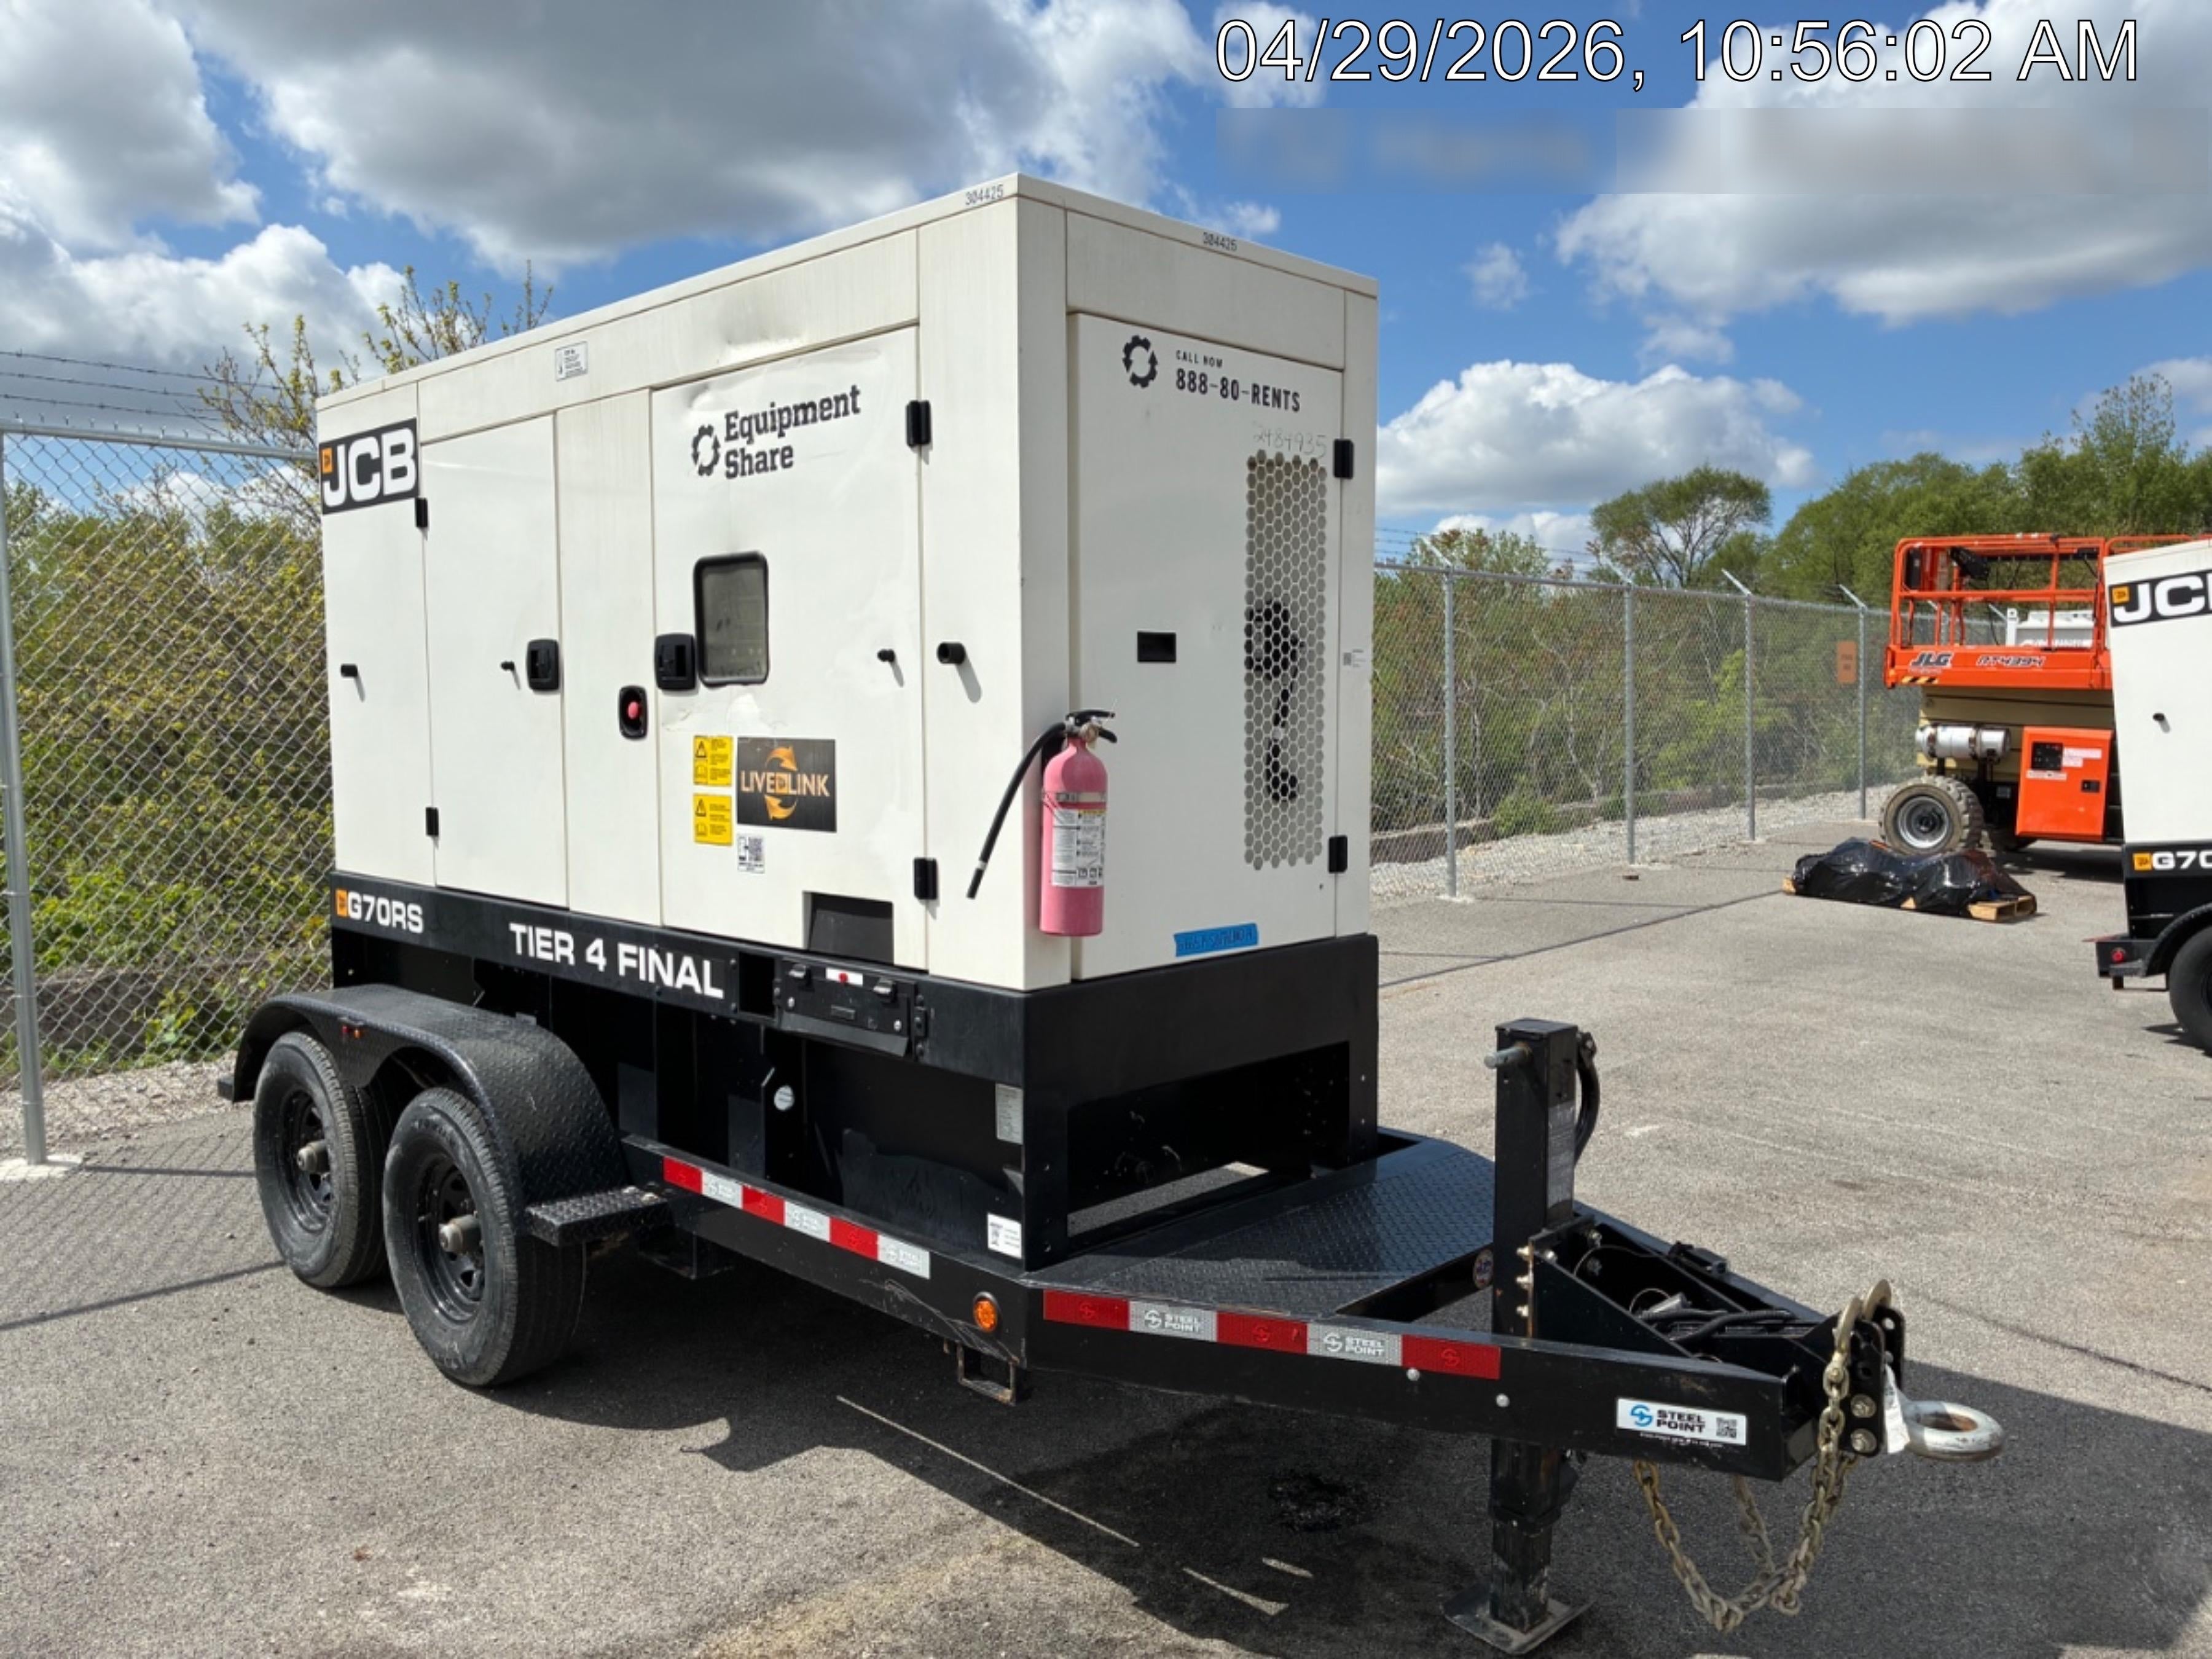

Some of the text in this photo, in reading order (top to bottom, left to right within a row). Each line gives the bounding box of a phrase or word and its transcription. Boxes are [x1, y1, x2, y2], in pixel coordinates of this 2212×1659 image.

[1175, 350, 1223, 368] CALL NOW
[1176, 368, 1300, 412] 888-80-RENTS
[724, 385, 860, 444] Equipment
[323, 428, 416, 507] JCB
[724, 445, 793, 479] Share
[2114, 572, 2212, 622] JC
[1912, 653, 1952, 667] JLG
[348, 891, 423, 933] G70RS
[509, 922, 724, 999] TIER 4 FINAL
[1657, 1410, 1704, 1424] STEEL
[1657, 1419, 1706, 1433] POINT
